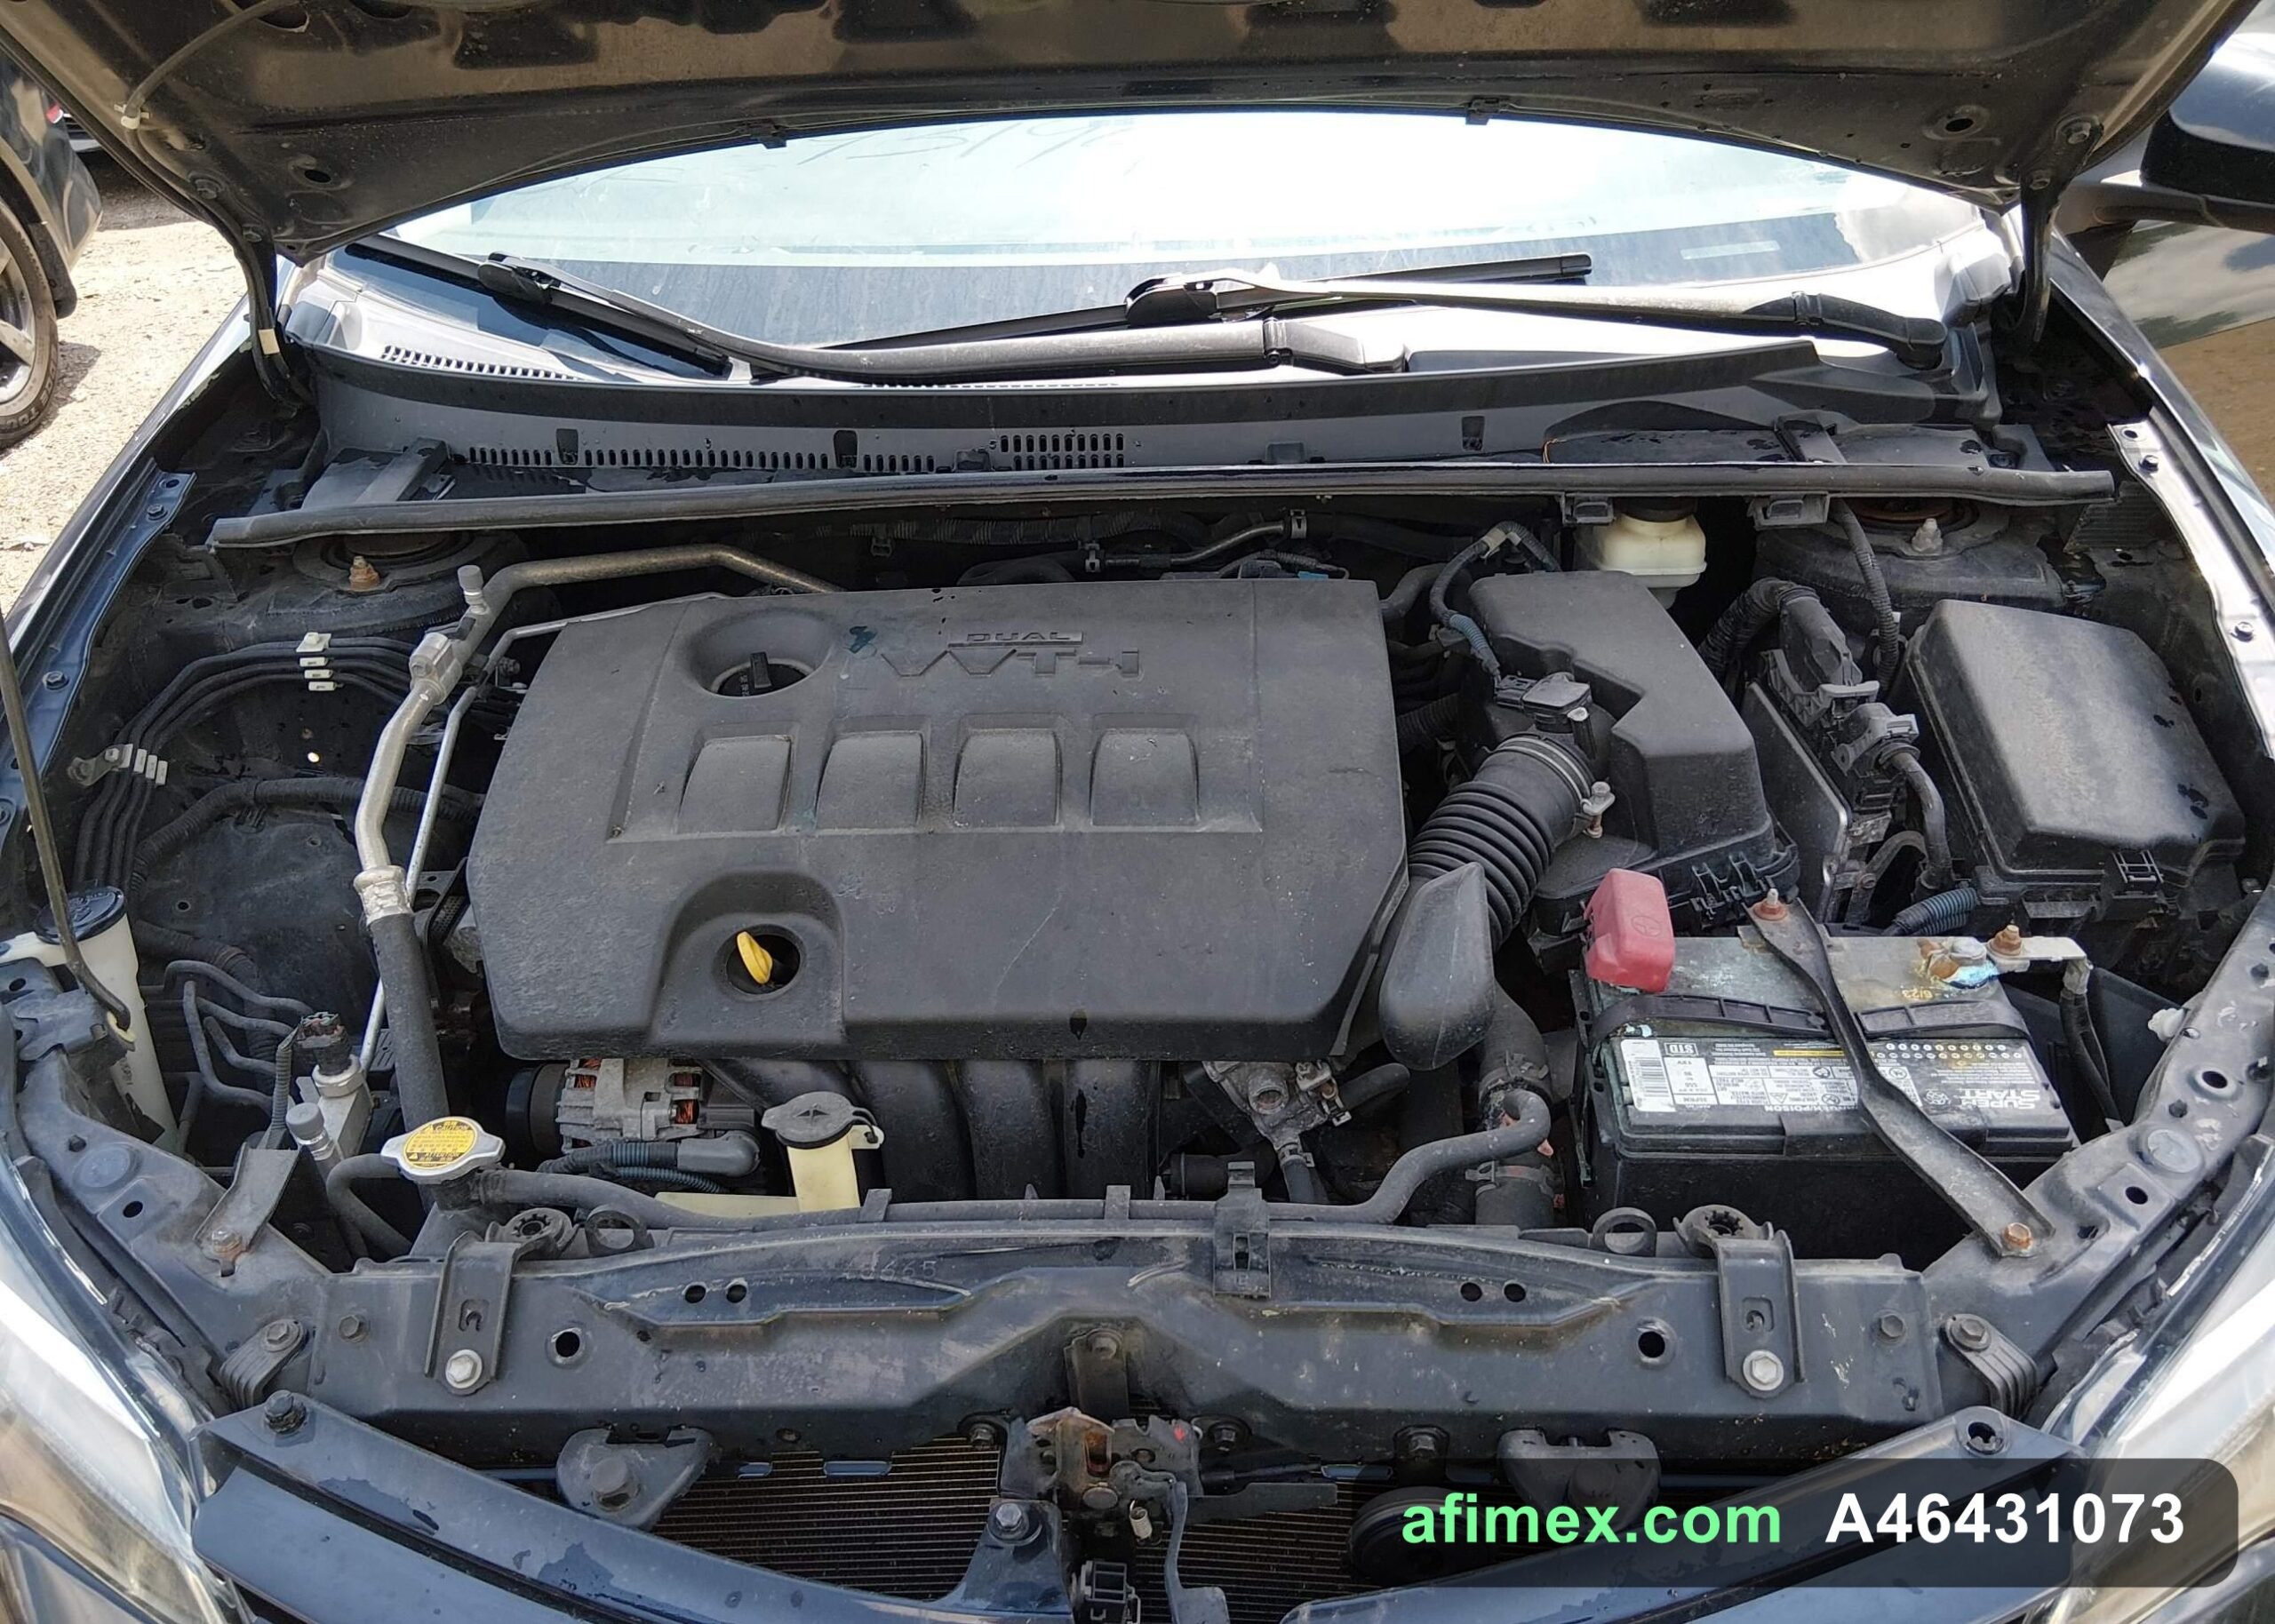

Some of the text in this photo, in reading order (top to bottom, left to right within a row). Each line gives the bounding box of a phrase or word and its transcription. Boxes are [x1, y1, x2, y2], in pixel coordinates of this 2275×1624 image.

[967, 632, 1071, 643] DUAL
[1669, 1044, 1695, 1054] STD
[1960, 1089, 2040, 1101] START
[1961, 1099, 2036, 1110] SUPER
